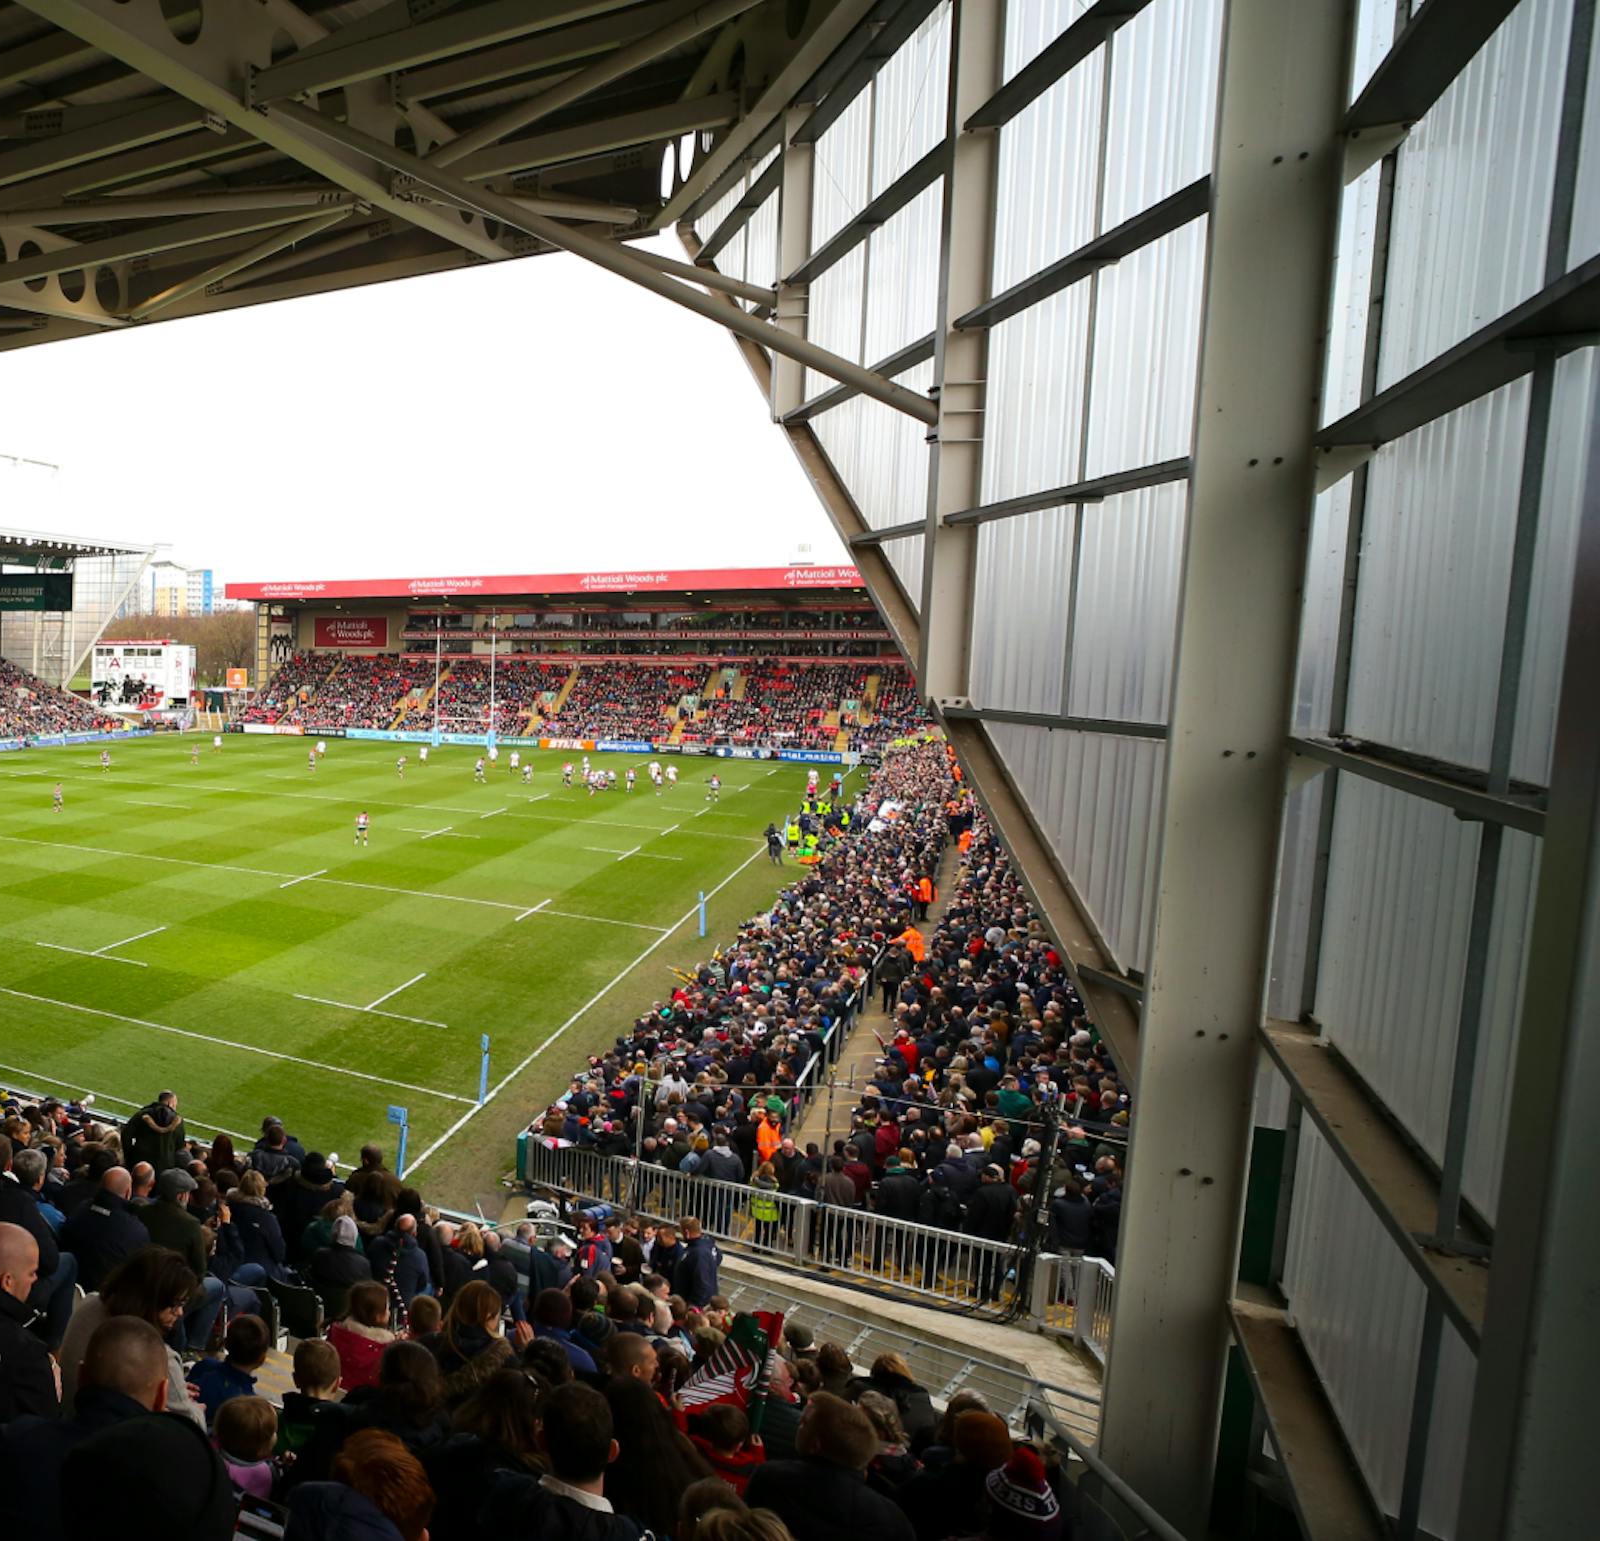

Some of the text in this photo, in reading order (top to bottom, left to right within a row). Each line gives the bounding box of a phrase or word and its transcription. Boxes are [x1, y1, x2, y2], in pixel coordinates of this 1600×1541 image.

[625, 573, 655, 583] Woods
[796, 569, 835, 579] Mattioli
[95, 657, 163, 669] HÄFELE
